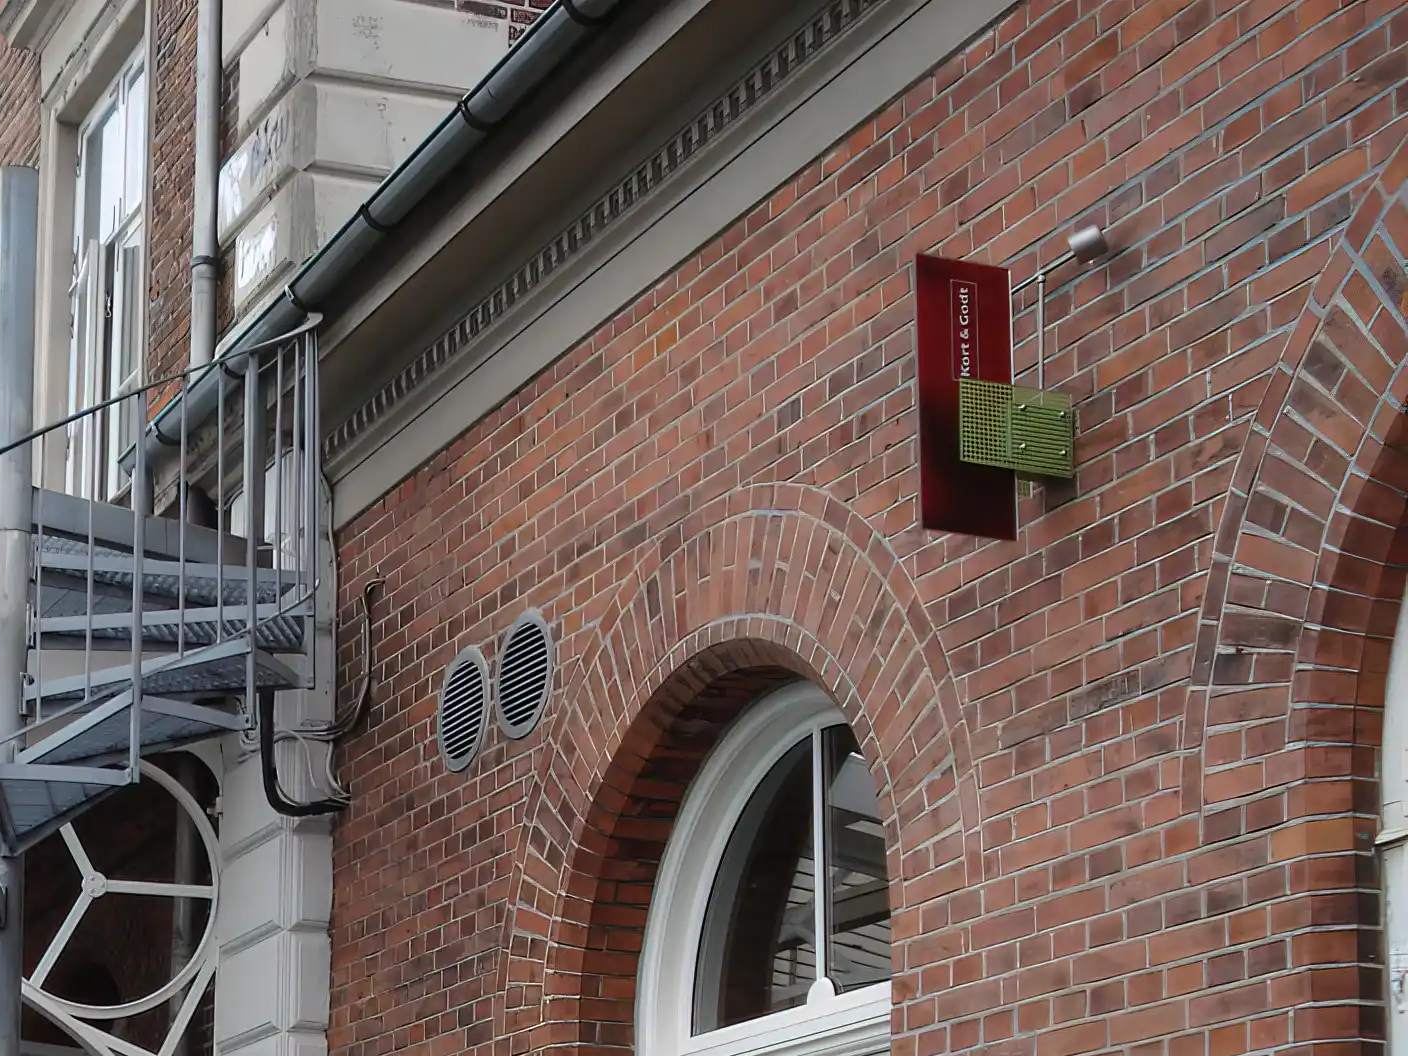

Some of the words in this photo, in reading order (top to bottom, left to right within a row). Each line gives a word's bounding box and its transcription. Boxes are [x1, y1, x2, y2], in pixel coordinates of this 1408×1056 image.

[959, 288, 969, 325] Godt
[960, 328, 969, 339] &
[960, 343, 971, 377] Kort
